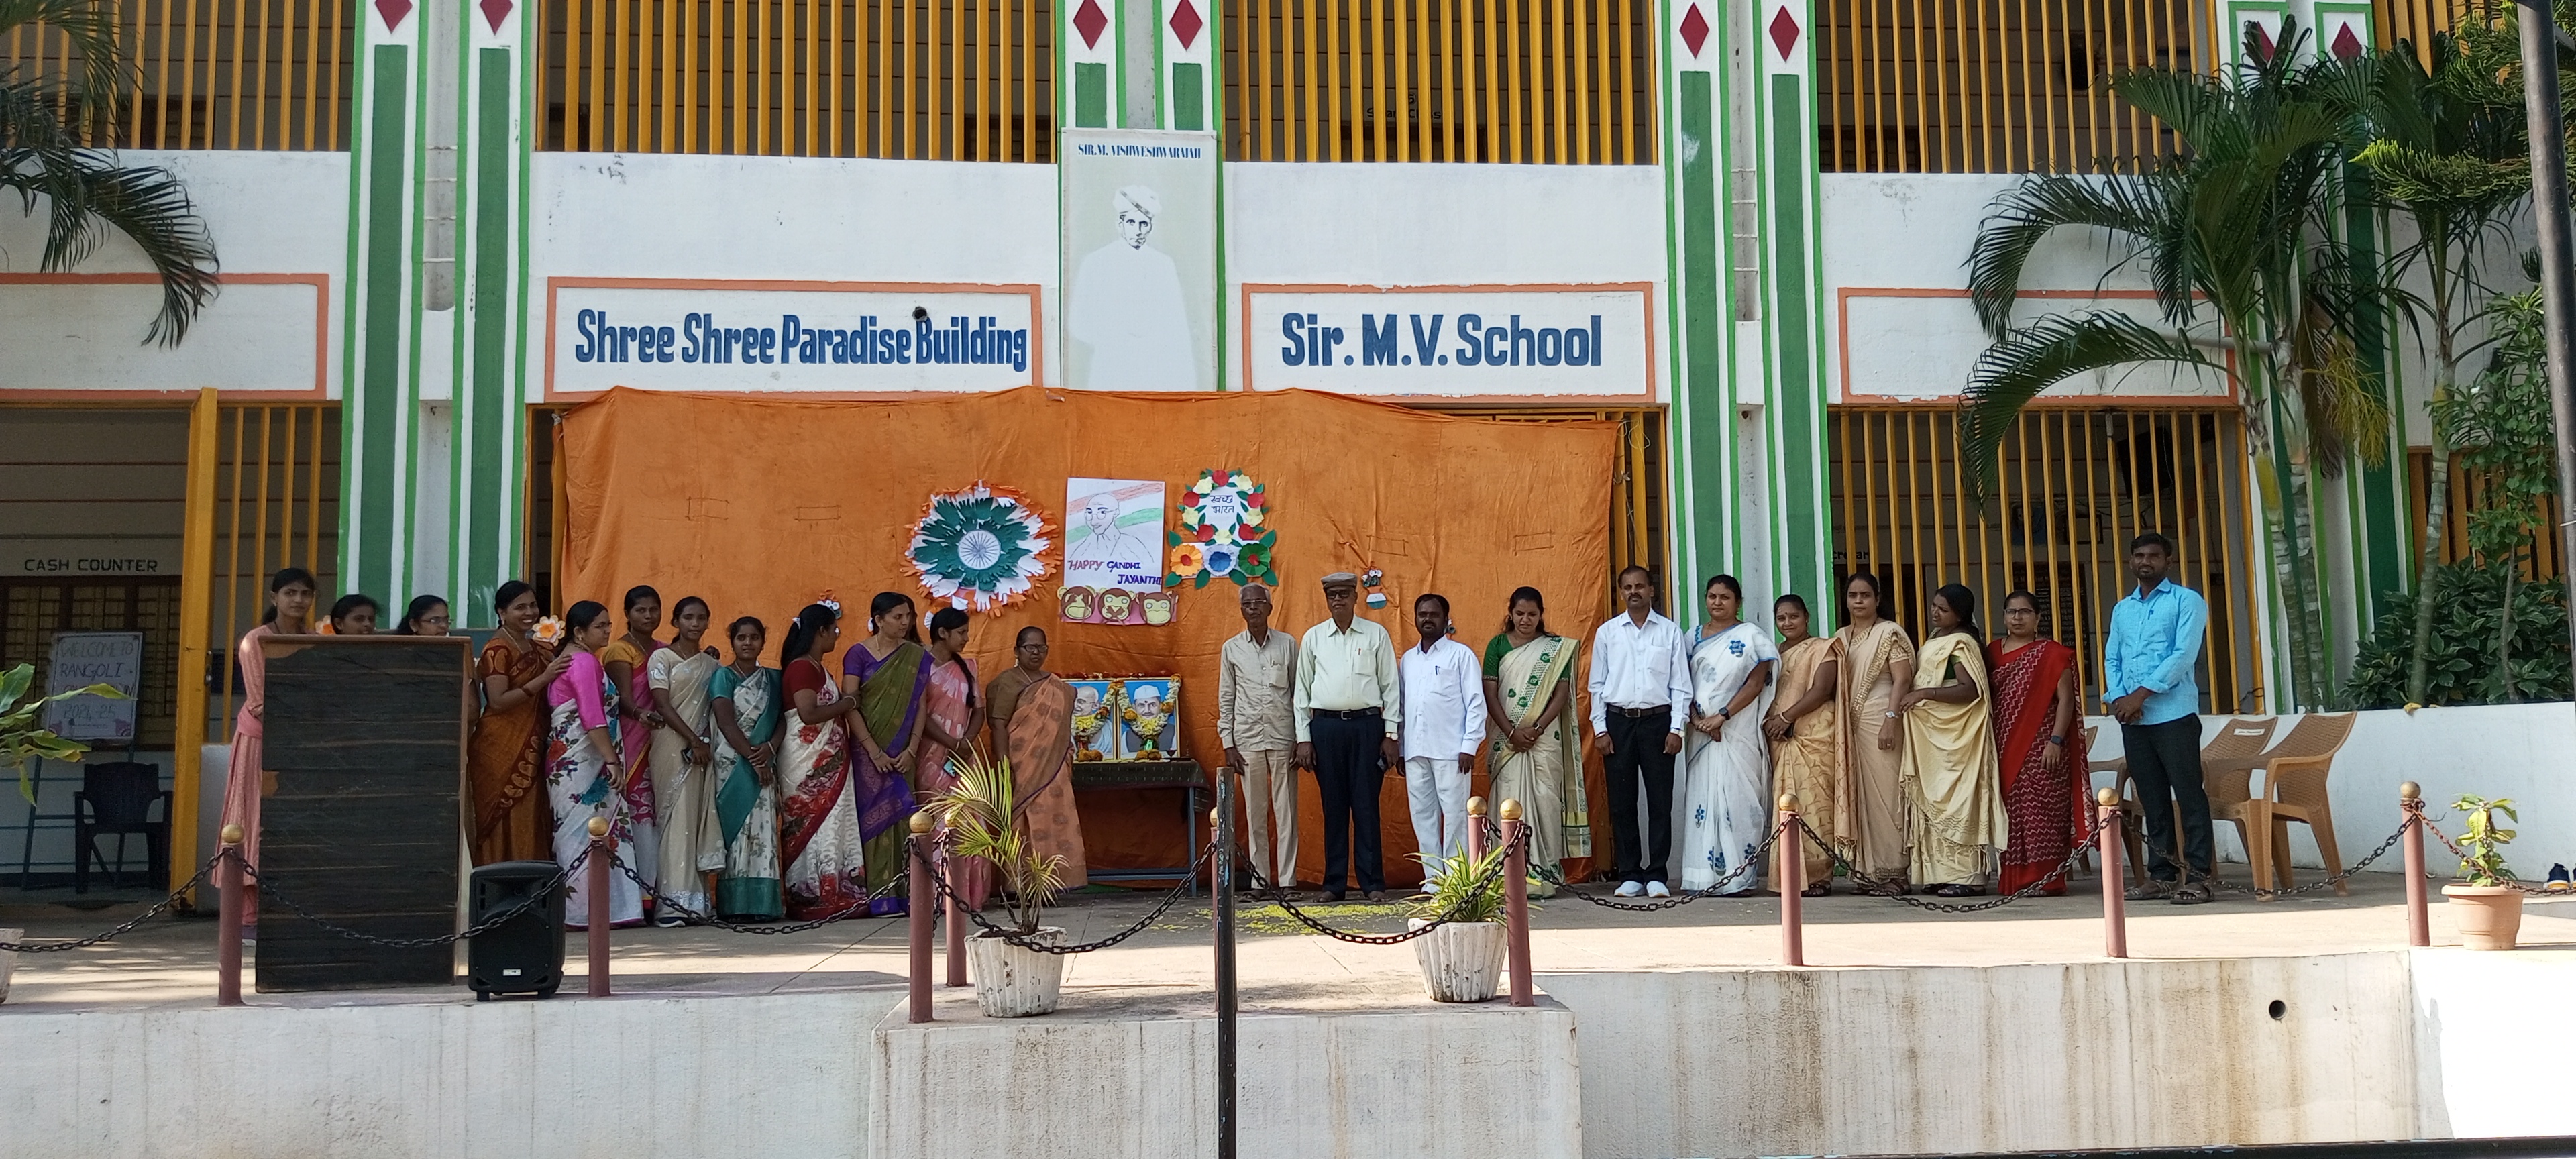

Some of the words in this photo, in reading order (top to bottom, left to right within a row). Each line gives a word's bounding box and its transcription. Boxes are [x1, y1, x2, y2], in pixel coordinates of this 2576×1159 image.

[1409, 109, 1441, 119] Cls
[575, 309, 675, 363] Shree
[682, 313, 775, 364] Shree
[781, 315, 912, 365] Paradise
[915, 315, 1027, 372] Building
[1282, 313, 1354, 366] Sir.
[1362, 313, 1448, 368] M.V.
[1456, 313, 1601, 366] School
[1211, 505, 1234, 514] भारत
[25, 559, 70, 571] CASH
[78, 559, 158, 572] COUNTER
[1068, 559, 1104, 571] HAPPY
[1106, 561, 1141, 572] GANDHI
[1117, 574, 1162, 585] JAYANTHI
[60, 662, 124, 681] RANGOLI
